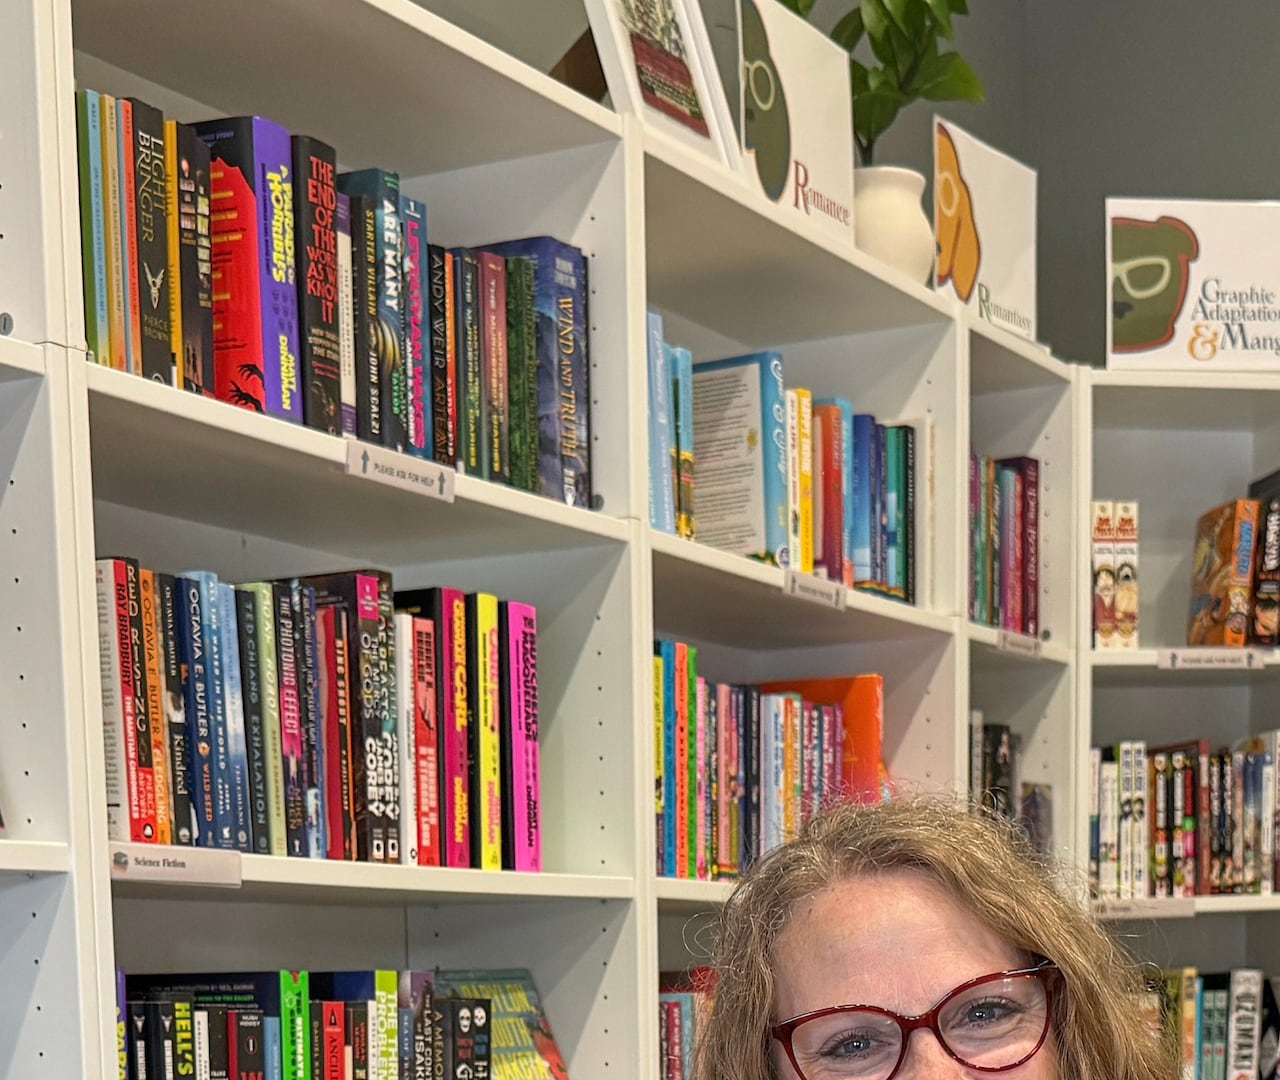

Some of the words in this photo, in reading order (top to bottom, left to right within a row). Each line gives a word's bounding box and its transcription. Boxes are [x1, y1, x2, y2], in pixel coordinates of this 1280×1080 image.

[138, 130, 155, 243] BRINGER
[150, 136, 165, 214] LIGHT
[793, 158, 851, 227] Romance
[976, 281, 1032, 332] Romantasy
[1200, 279, 1275, 305] Graphic
[558, 295, 573, 355] WIND
[1188, 323, 1218, 361] &
[561, 394, 578, 460] TRUTH
[374, 463, 395, 477] PLEASE
[395, 469, 408, 481] ASK
[408, 472, 419, 484] FOR
[419, 475, 436, 489] HELP
[127, 565, 139, 617] RED
[189, 587, 205, 660] OCTAVIA
[131, 629, 147, 733] RISING
[194, 681, 208, 741] BUTLER
[173, 733, 187, 797] Kindred
[133, 856, 160, 869] Science
[162, 857, 186, 870] Fiction
[175, 1002, 193, 1076] HELL'S
